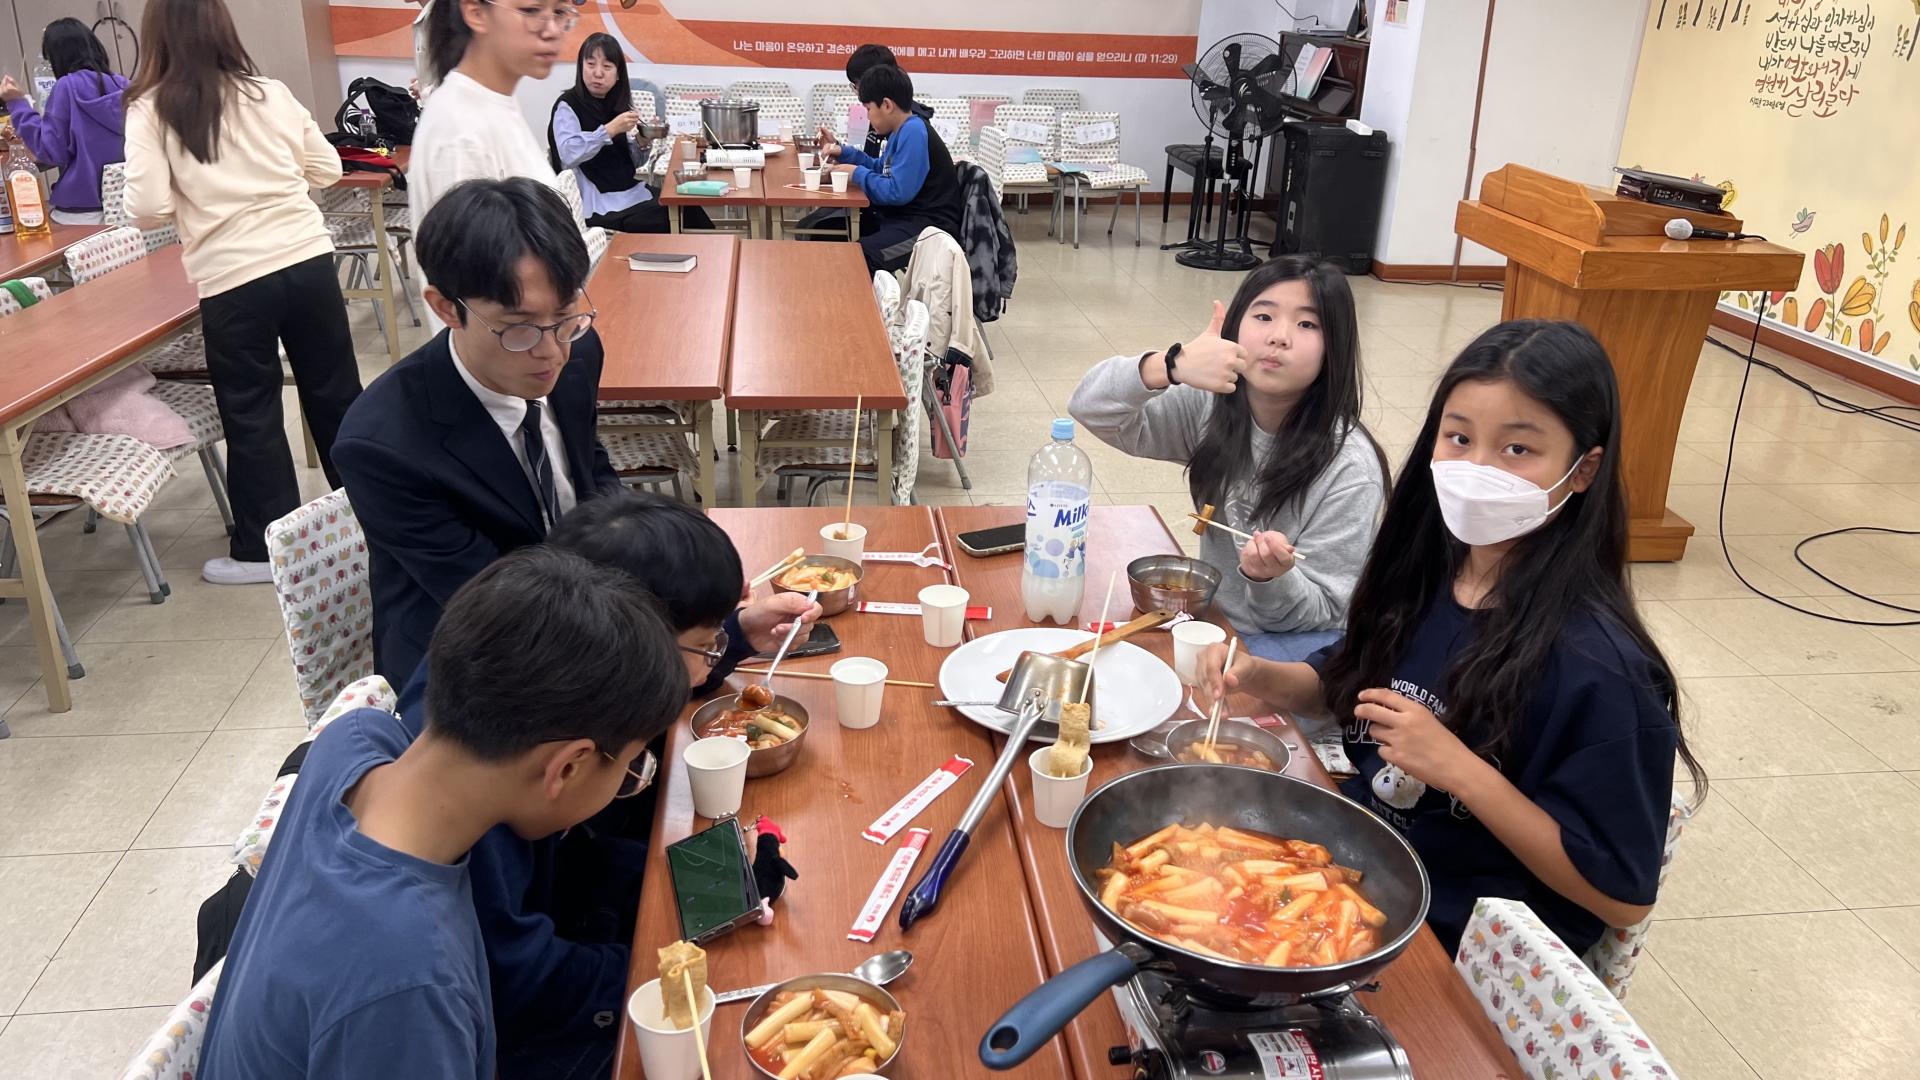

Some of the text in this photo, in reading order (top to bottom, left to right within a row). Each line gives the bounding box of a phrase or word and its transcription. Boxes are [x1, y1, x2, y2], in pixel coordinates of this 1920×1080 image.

[733, 39, 753, 52] 나는
[755, 40, 784, 52] 마음이
[786, 42, 825, 54] 온유하고
[827, 43, 858, 55] 겸손하
[918, 47, 937, 58] 메고
[938, 48, 957, 58] 내게
[959, 48, 987, 59] 배우라
[989, 49, 1025, 61] 그리하면
[1026, 50, 1045, 61] 너희
[1047, 51, 1074, 62] 마음이
[1076, 51, 1094, 63] 쉼을
[1096, 52, 1132, 63] 얻으리니
[1150, 53, 1178, 64] 11:29)
[1765, 31, 1797, 53] 반드시
[1391, 677, 1428, 701] WORLD
